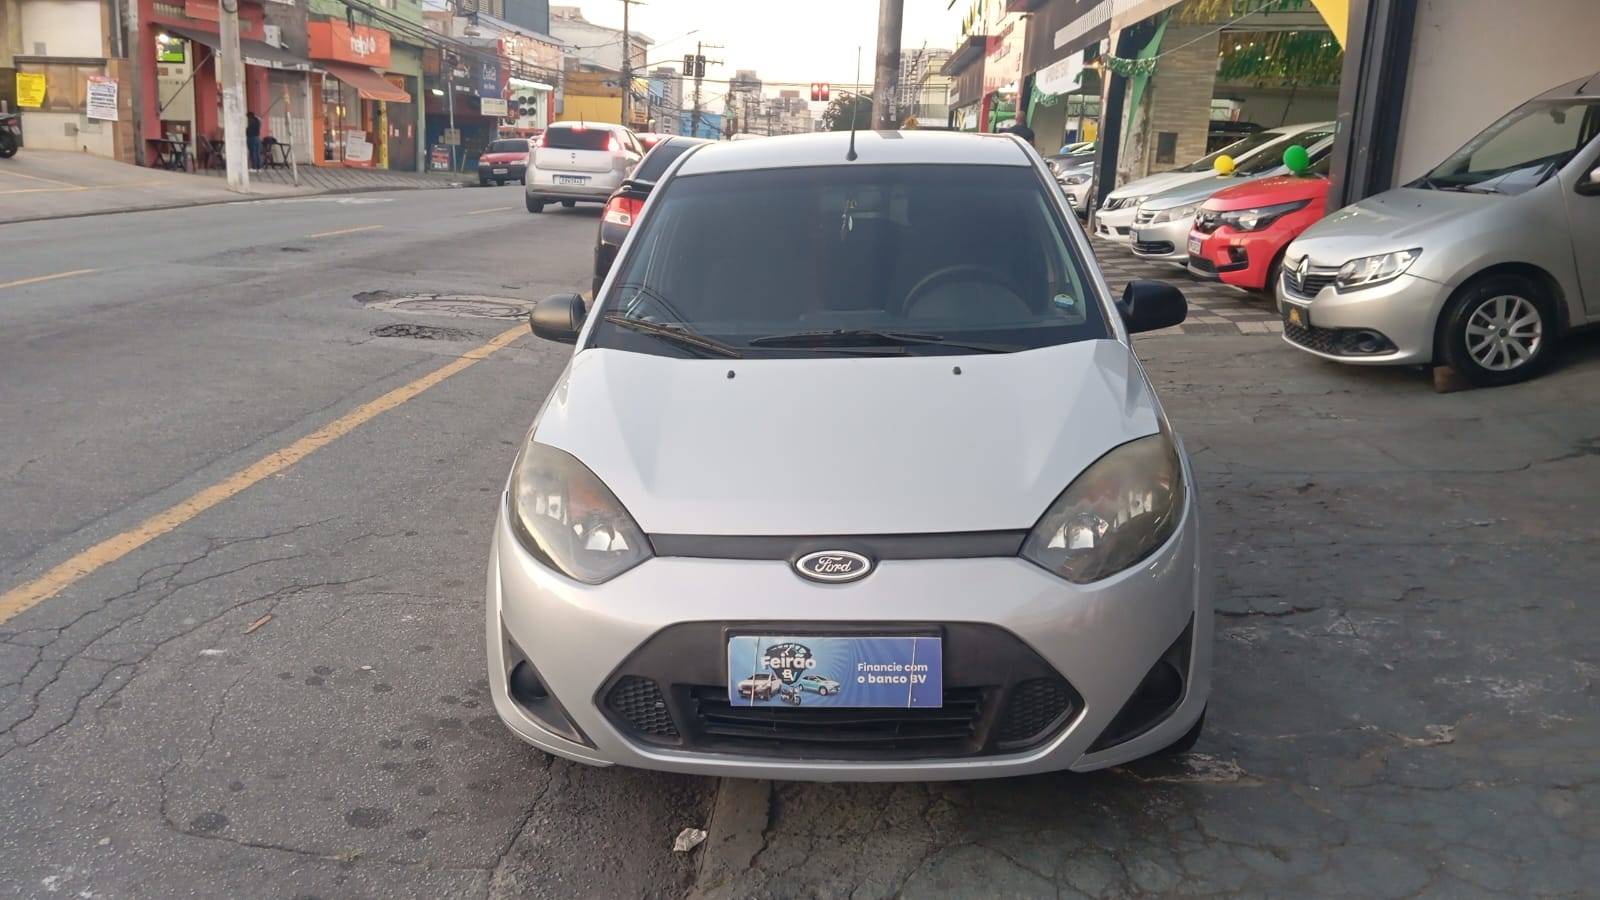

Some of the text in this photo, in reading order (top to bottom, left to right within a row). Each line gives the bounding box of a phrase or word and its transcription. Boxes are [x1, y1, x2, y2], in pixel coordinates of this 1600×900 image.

[815, 557, 852, 572] Ford
[760, 652, 817, 669] Feirão
[857, 662, 928, 672] Financie com
[857, 673, 927, 684] o banco BV
